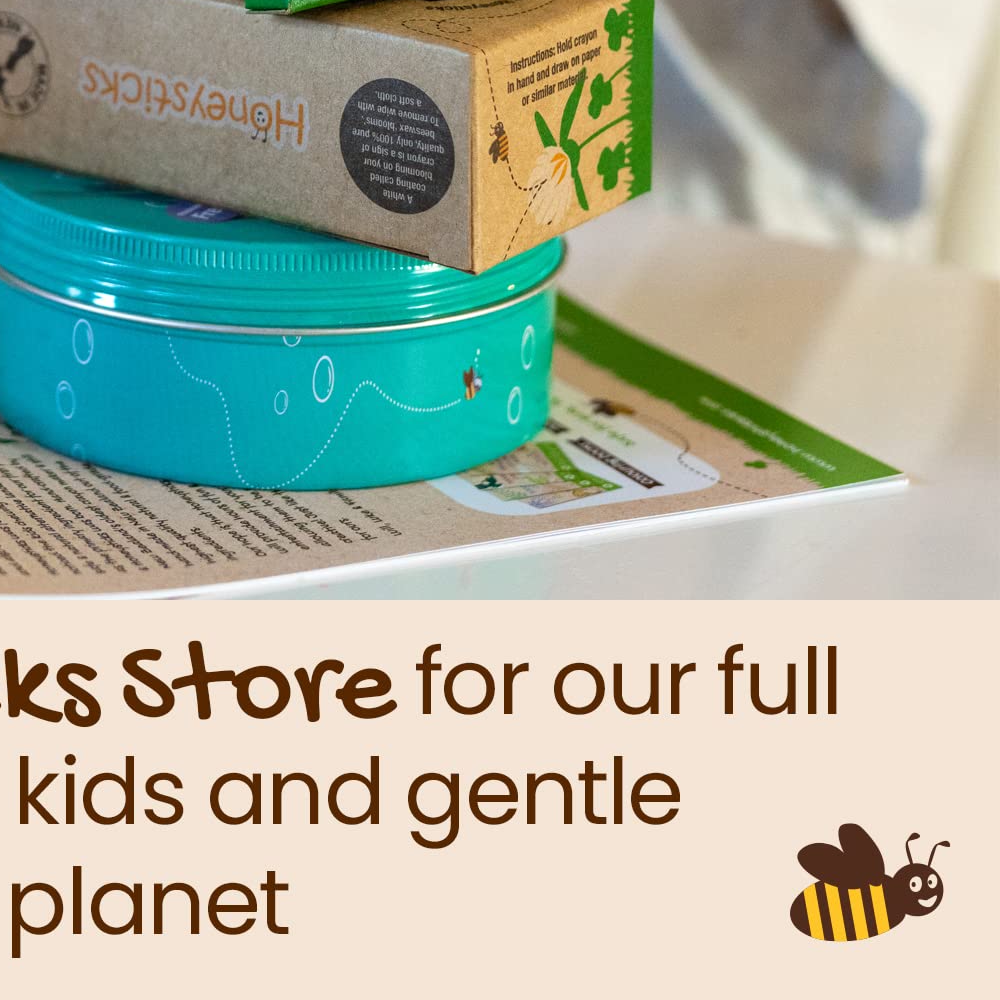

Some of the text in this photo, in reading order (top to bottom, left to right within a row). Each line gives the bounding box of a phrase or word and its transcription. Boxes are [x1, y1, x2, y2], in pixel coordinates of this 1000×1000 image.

[510, 29, 598, 73] Instructions: Hold crayon
[507, 46, 602, 93] in hand and draw on paper
[83, 62, 304, 146] Honeysticks
[375, 91, 422, 107] a soft cloth.
[522, 96, 530, 106] or
[531, 85, 556, 103] similar
[358, 101, 439, 126] To remove wipe with
[352, 128, 370, 139] pure
[372, 132, 394, 145] 100%
[396, 136, 413, 147] only
[400, 124, 435, 139] beeswax
[361, 144, 434, 166] crayon is a sign of
[364, 158, 432, 181] blooming on your
[370, 173, 426, 192] coating called
[383, 189, 405, 201] white
